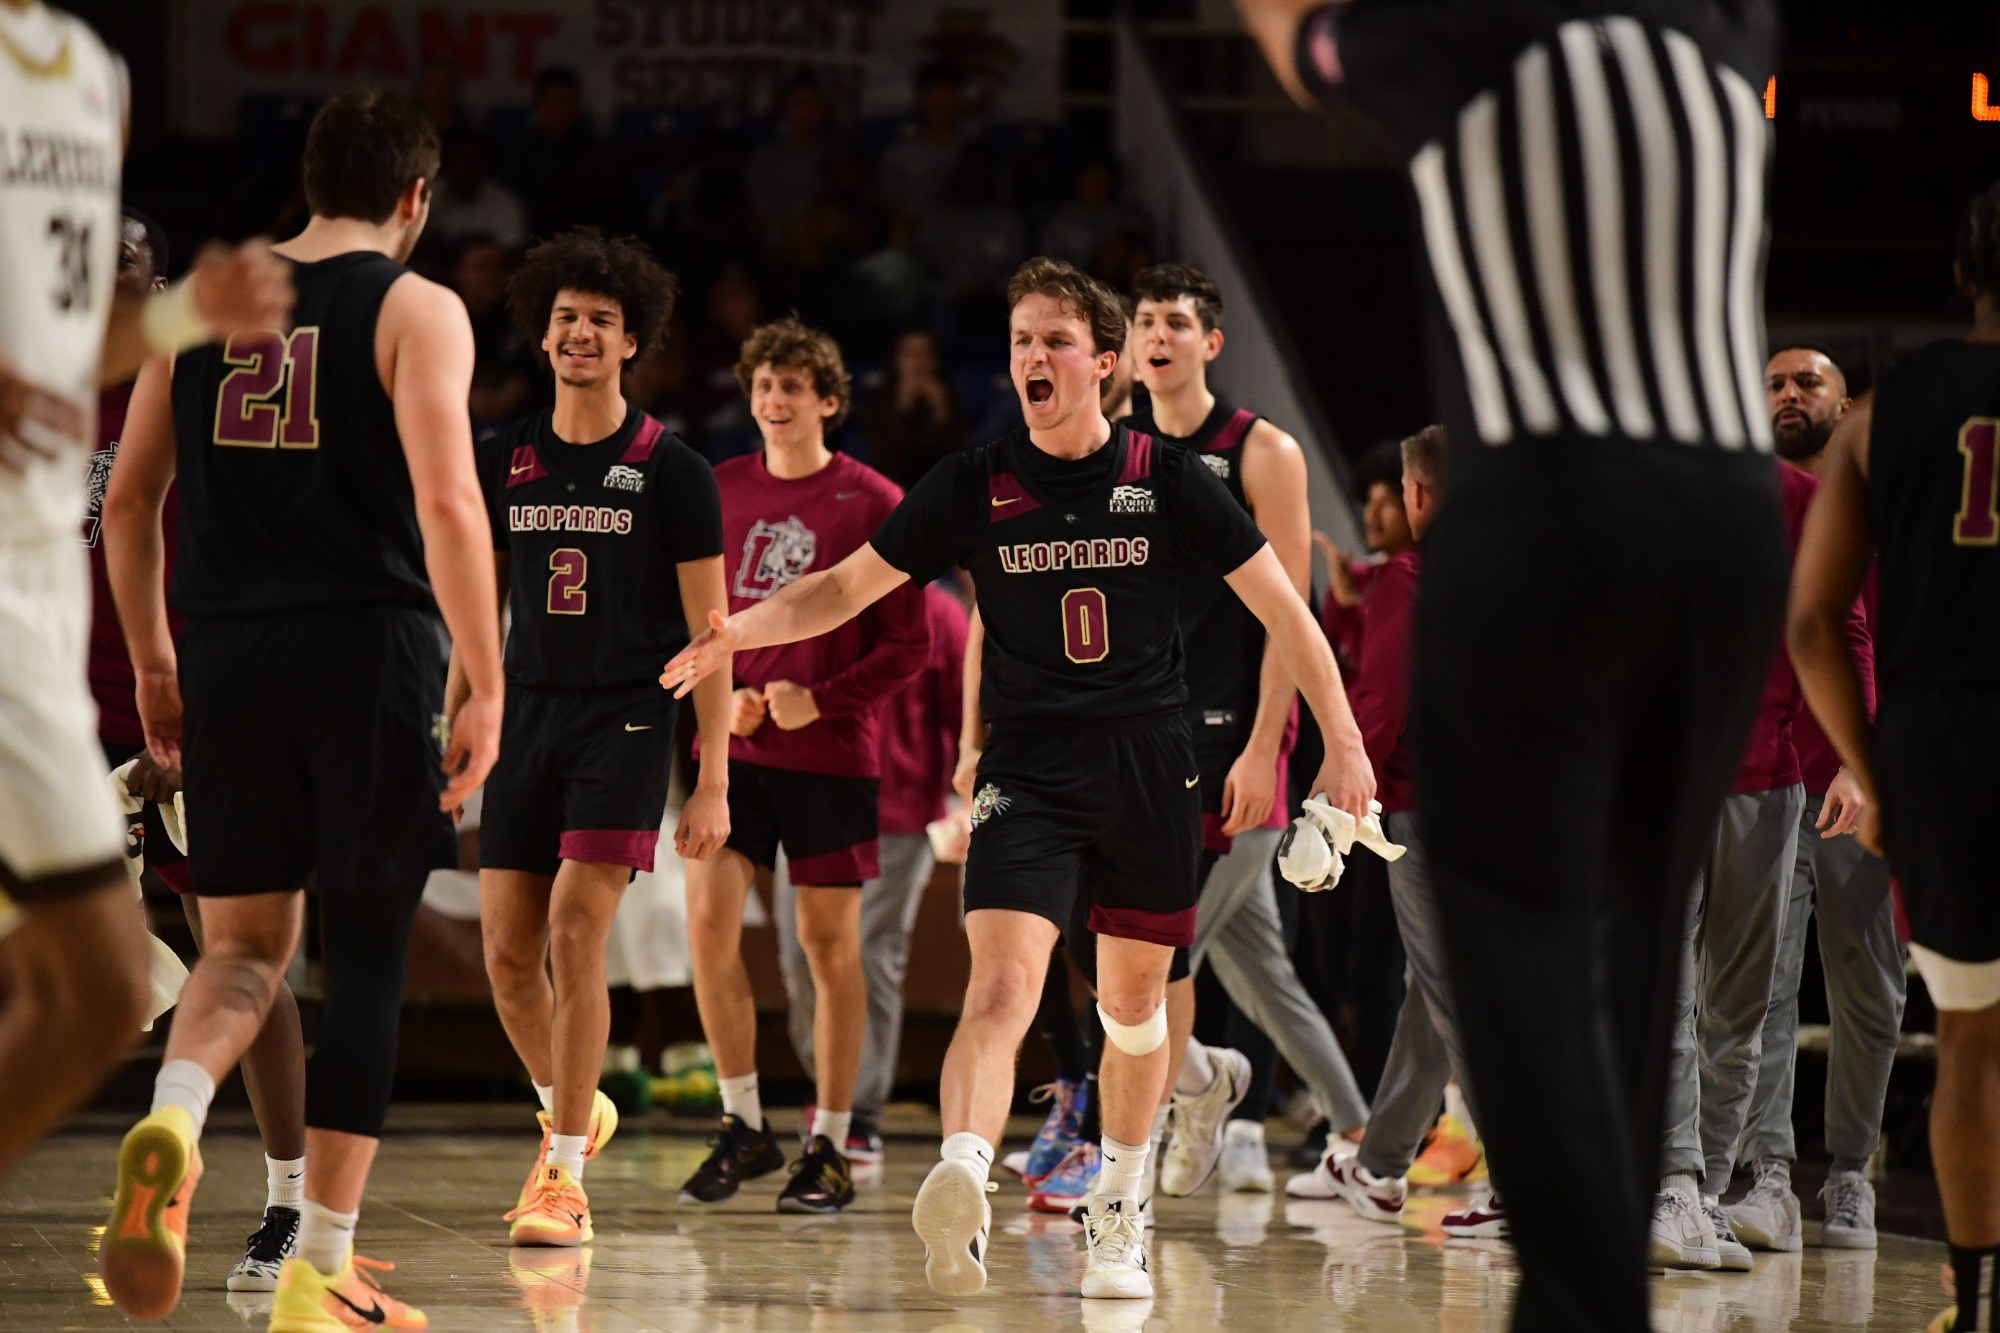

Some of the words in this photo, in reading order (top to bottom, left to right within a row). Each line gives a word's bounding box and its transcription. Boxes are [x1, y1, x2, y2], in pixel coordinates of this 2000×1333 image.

[223, 3, 562, 82] GIANT
[213, 326, 320, 449] 21
[509, 505, 632, 534] LEOPARDS
[1109, 498, 1157, 507] PATRIOT
[1109, 505, 1156, 513] LEAGUE
[998, 537, 1150, 573] LEOPARDS
[547, 548, 587, 615] 2
[1061, 587, 1109, 664] 0
